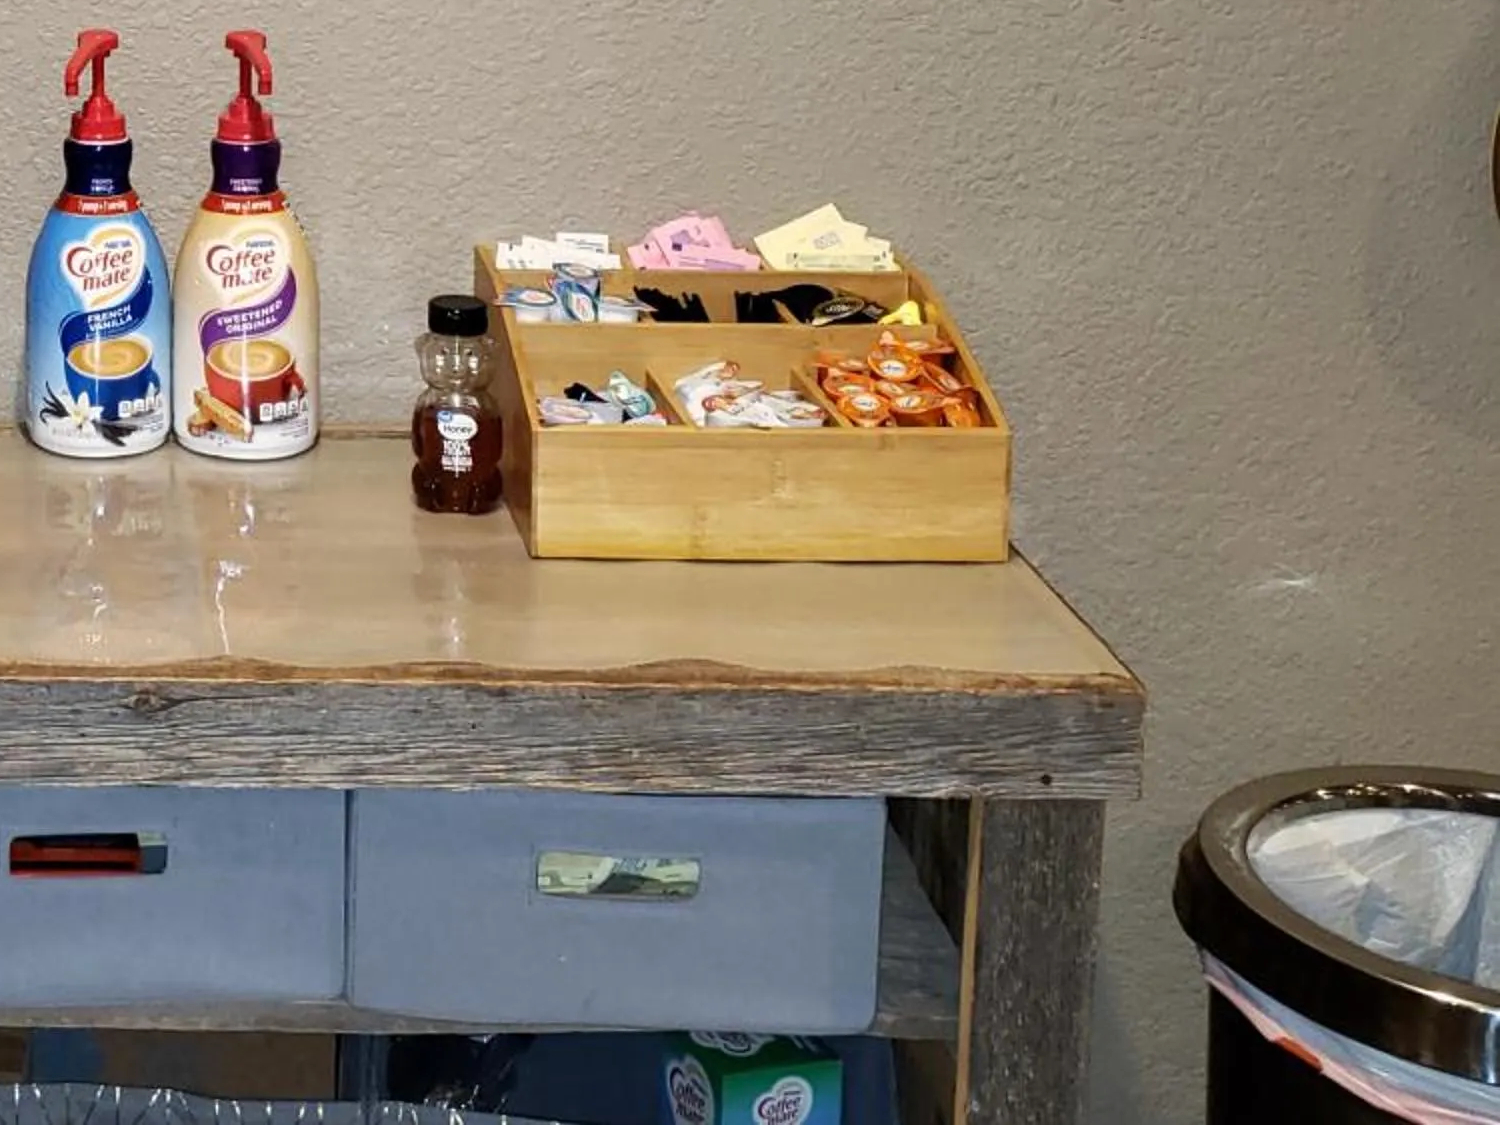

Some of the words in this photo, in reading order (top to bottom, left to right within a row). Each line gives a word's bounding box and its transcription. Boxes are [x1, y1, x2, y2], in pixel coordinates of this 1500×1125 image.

[67, 246, 133, 277] Coffee
[206, 244, 275, 275] Coffee
[83, 267, 131, 291] mate
[217, 299, 283, 326] SWEETENED
[443, 424, 473, 434] Honey
[758, 1096, 801, 1119] Coffee
